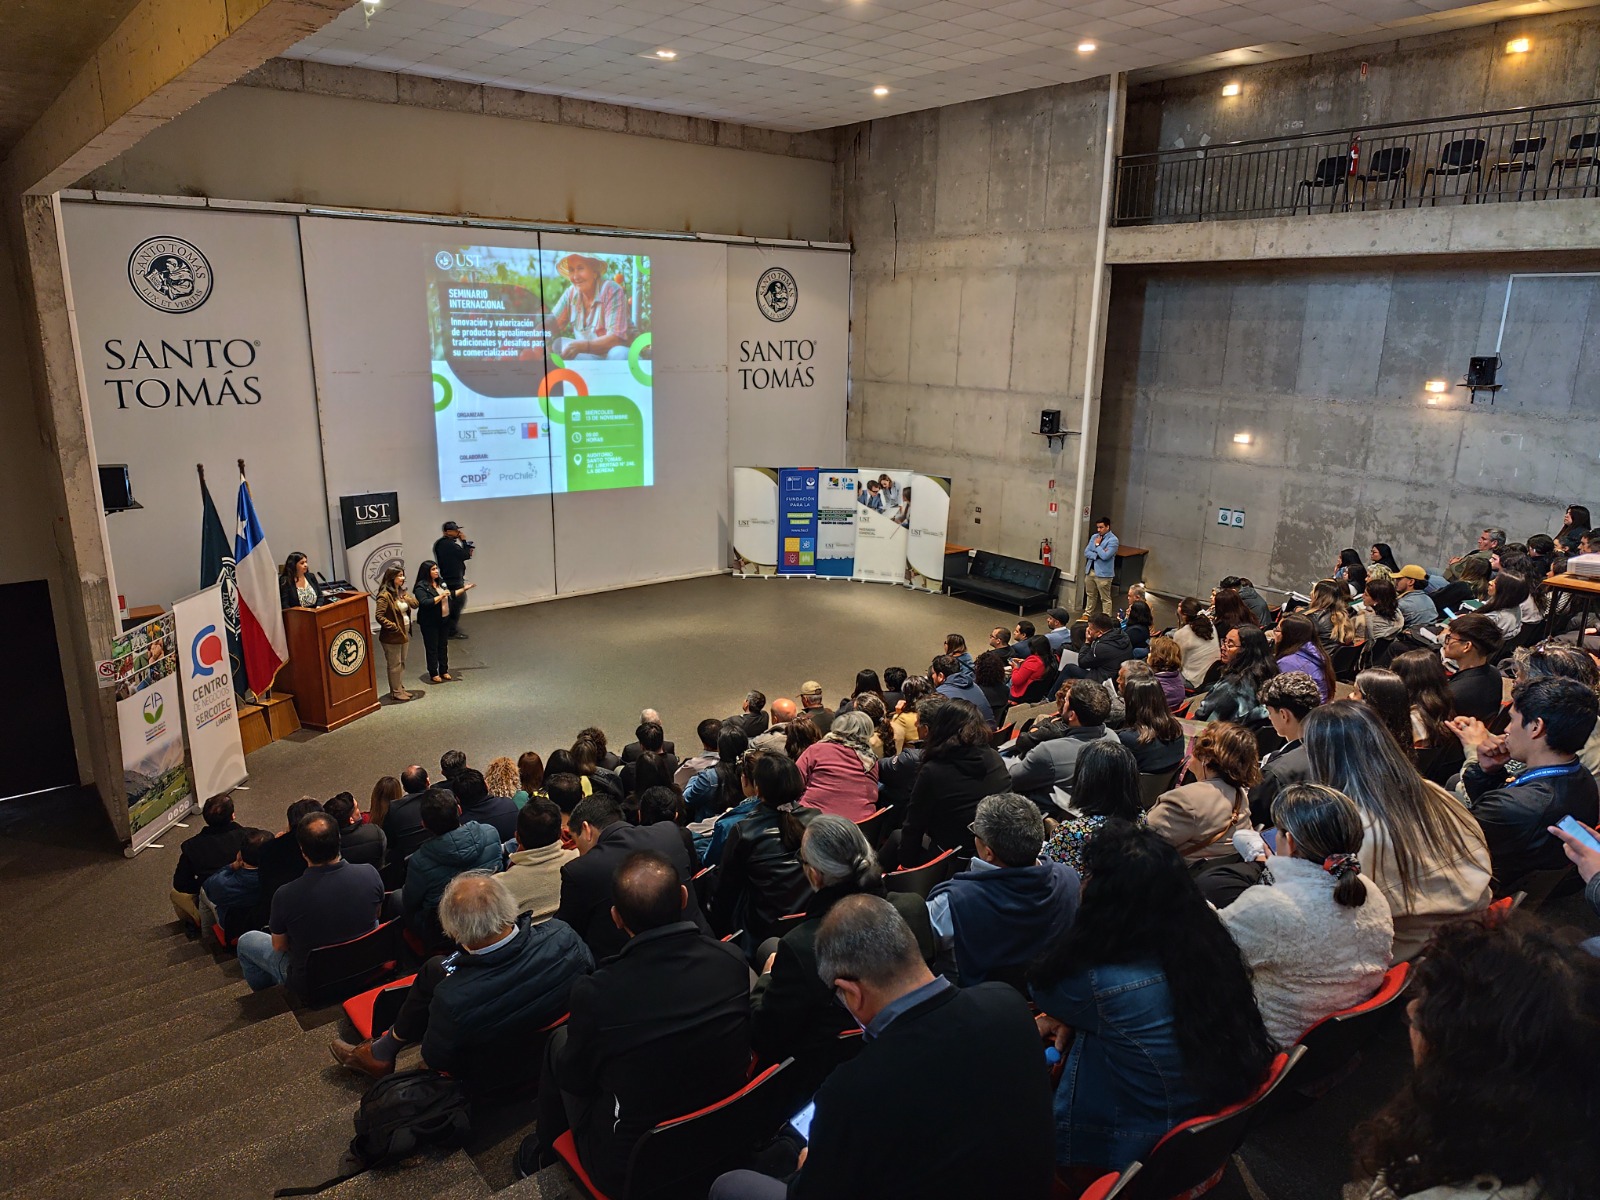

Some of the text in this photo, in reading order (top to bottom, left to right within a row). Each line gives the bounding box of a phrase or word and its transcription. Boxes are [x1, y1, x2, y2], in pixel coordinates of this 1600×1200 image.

[136, 243, 206, 279] SANTO TOMÁS
[455, 253, 482, 267] UST
[142, 287, 203, 308] LUX ET VERITAS
[448, 288, 488, 299] SEMINARIO
[449, 299, 506, 310] INTERNACIONAL
[450, 317, 534, 328] Innovación y valorización
[451, 328, 461, 336] de
[462, 328, 495, 337] productos
[452, 338, 496, 347] tradicionales
[497, 340, 502, 348] y
[503, 338, 530, 347] desafíos
[463, 347, 518, 357] comercialización
[738, 362, 815, 390] TOMÁS
[104, 369, 262, 410] TOMÁS
[458, 430, 477, 439] UST
[460, 474, 487, 484] CRDP
[499, 472, 533, 481] ProChile
[354, 503, 390, 520] UST
[368, 550, 391, 580] SANTO
[192, 673, 228, 702] CENTRO
[145, 692, 163, 710] FIA
[193, 685, 230, 712] DE NEGOCIOS
[195, 697, 231, 727] SERCOTEC
